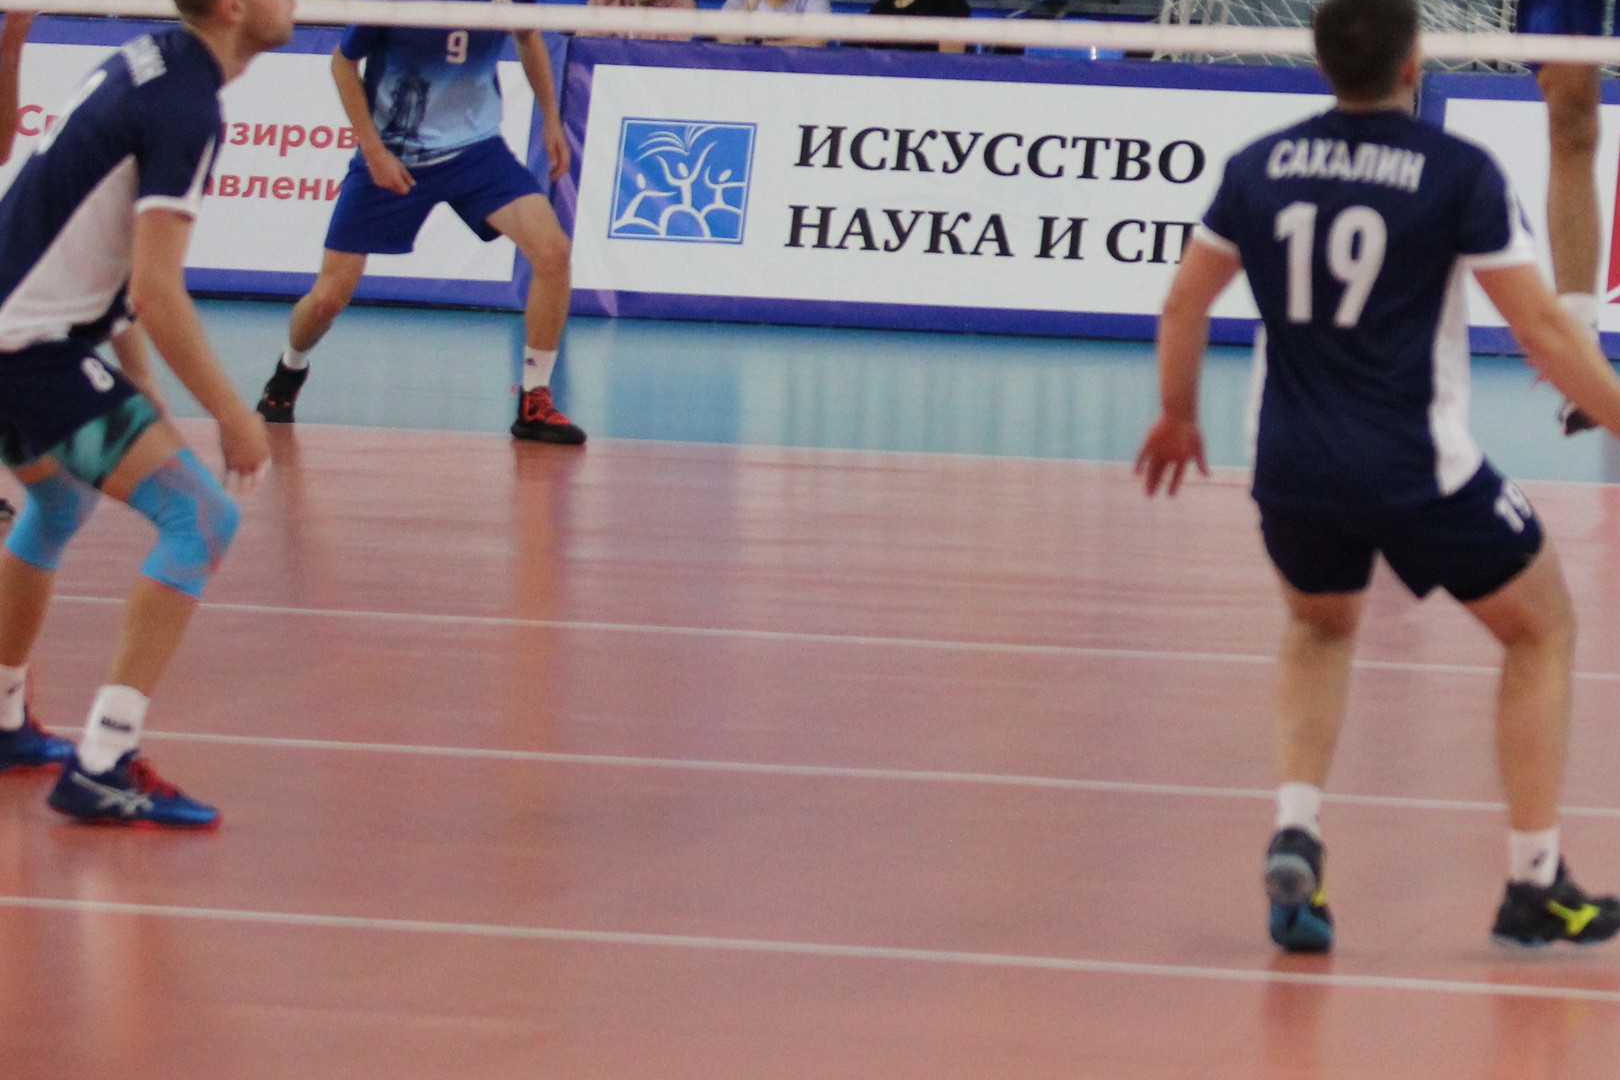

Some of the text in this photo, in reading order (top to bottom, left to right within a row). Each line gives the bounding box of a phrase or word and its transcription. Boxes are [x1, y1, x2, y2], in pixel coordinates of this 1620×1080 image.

[446, 29, 469, 65] 9
[793, 123, 1207, 185] ИСКУССТВО
[1266, 137, 1426, 194] САХАЛИН
[784, 204, 1015, 258] НАУКА
[1034, 216, 1090, 261] И
[1273, 200, 1388, 328] 19
